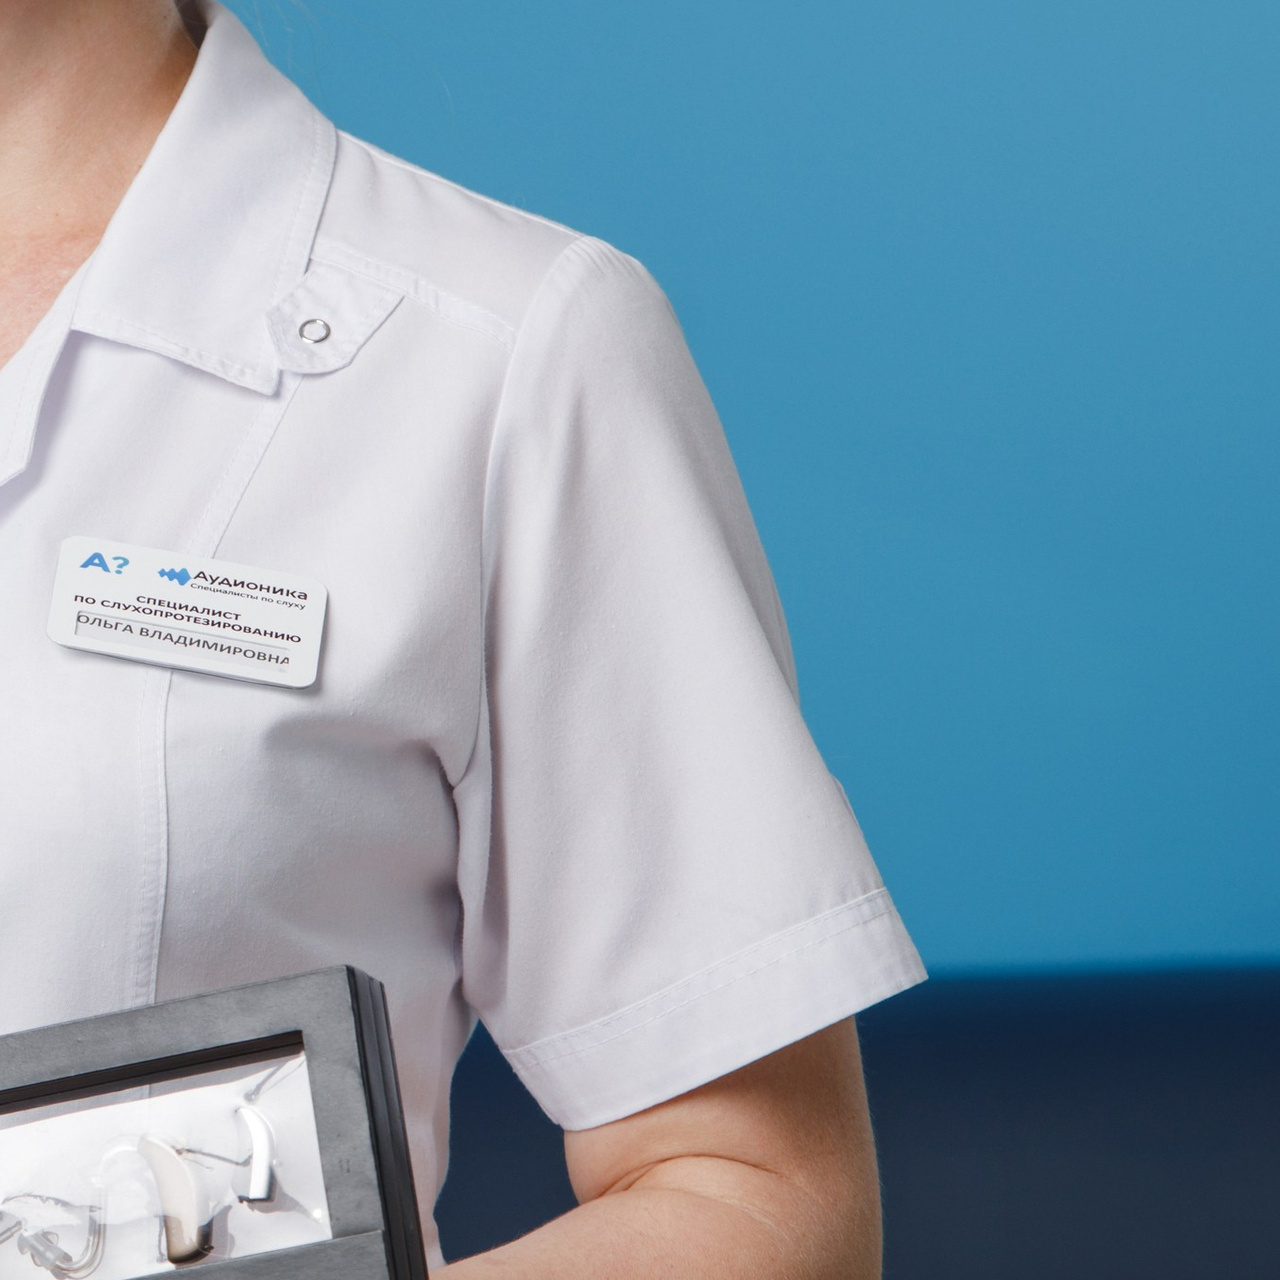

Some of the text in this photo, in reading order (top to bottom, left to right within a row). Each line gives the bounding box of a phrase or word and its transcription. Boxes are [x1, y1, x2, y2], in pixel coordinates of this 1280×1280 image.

[190, 582, 306, 610] Специалисты по слуху
[193, 570, 308, 601] Аудионика
[74, 594, 302, 643] ПО СЛУХОПРОТЕЗИРОВАНИЮ
[136, 595, 242, 621] СПЕЦИАЛИСТ
[77, 614, 290, 665] ОЛЬГА ВЛАДИМИРОВНА
